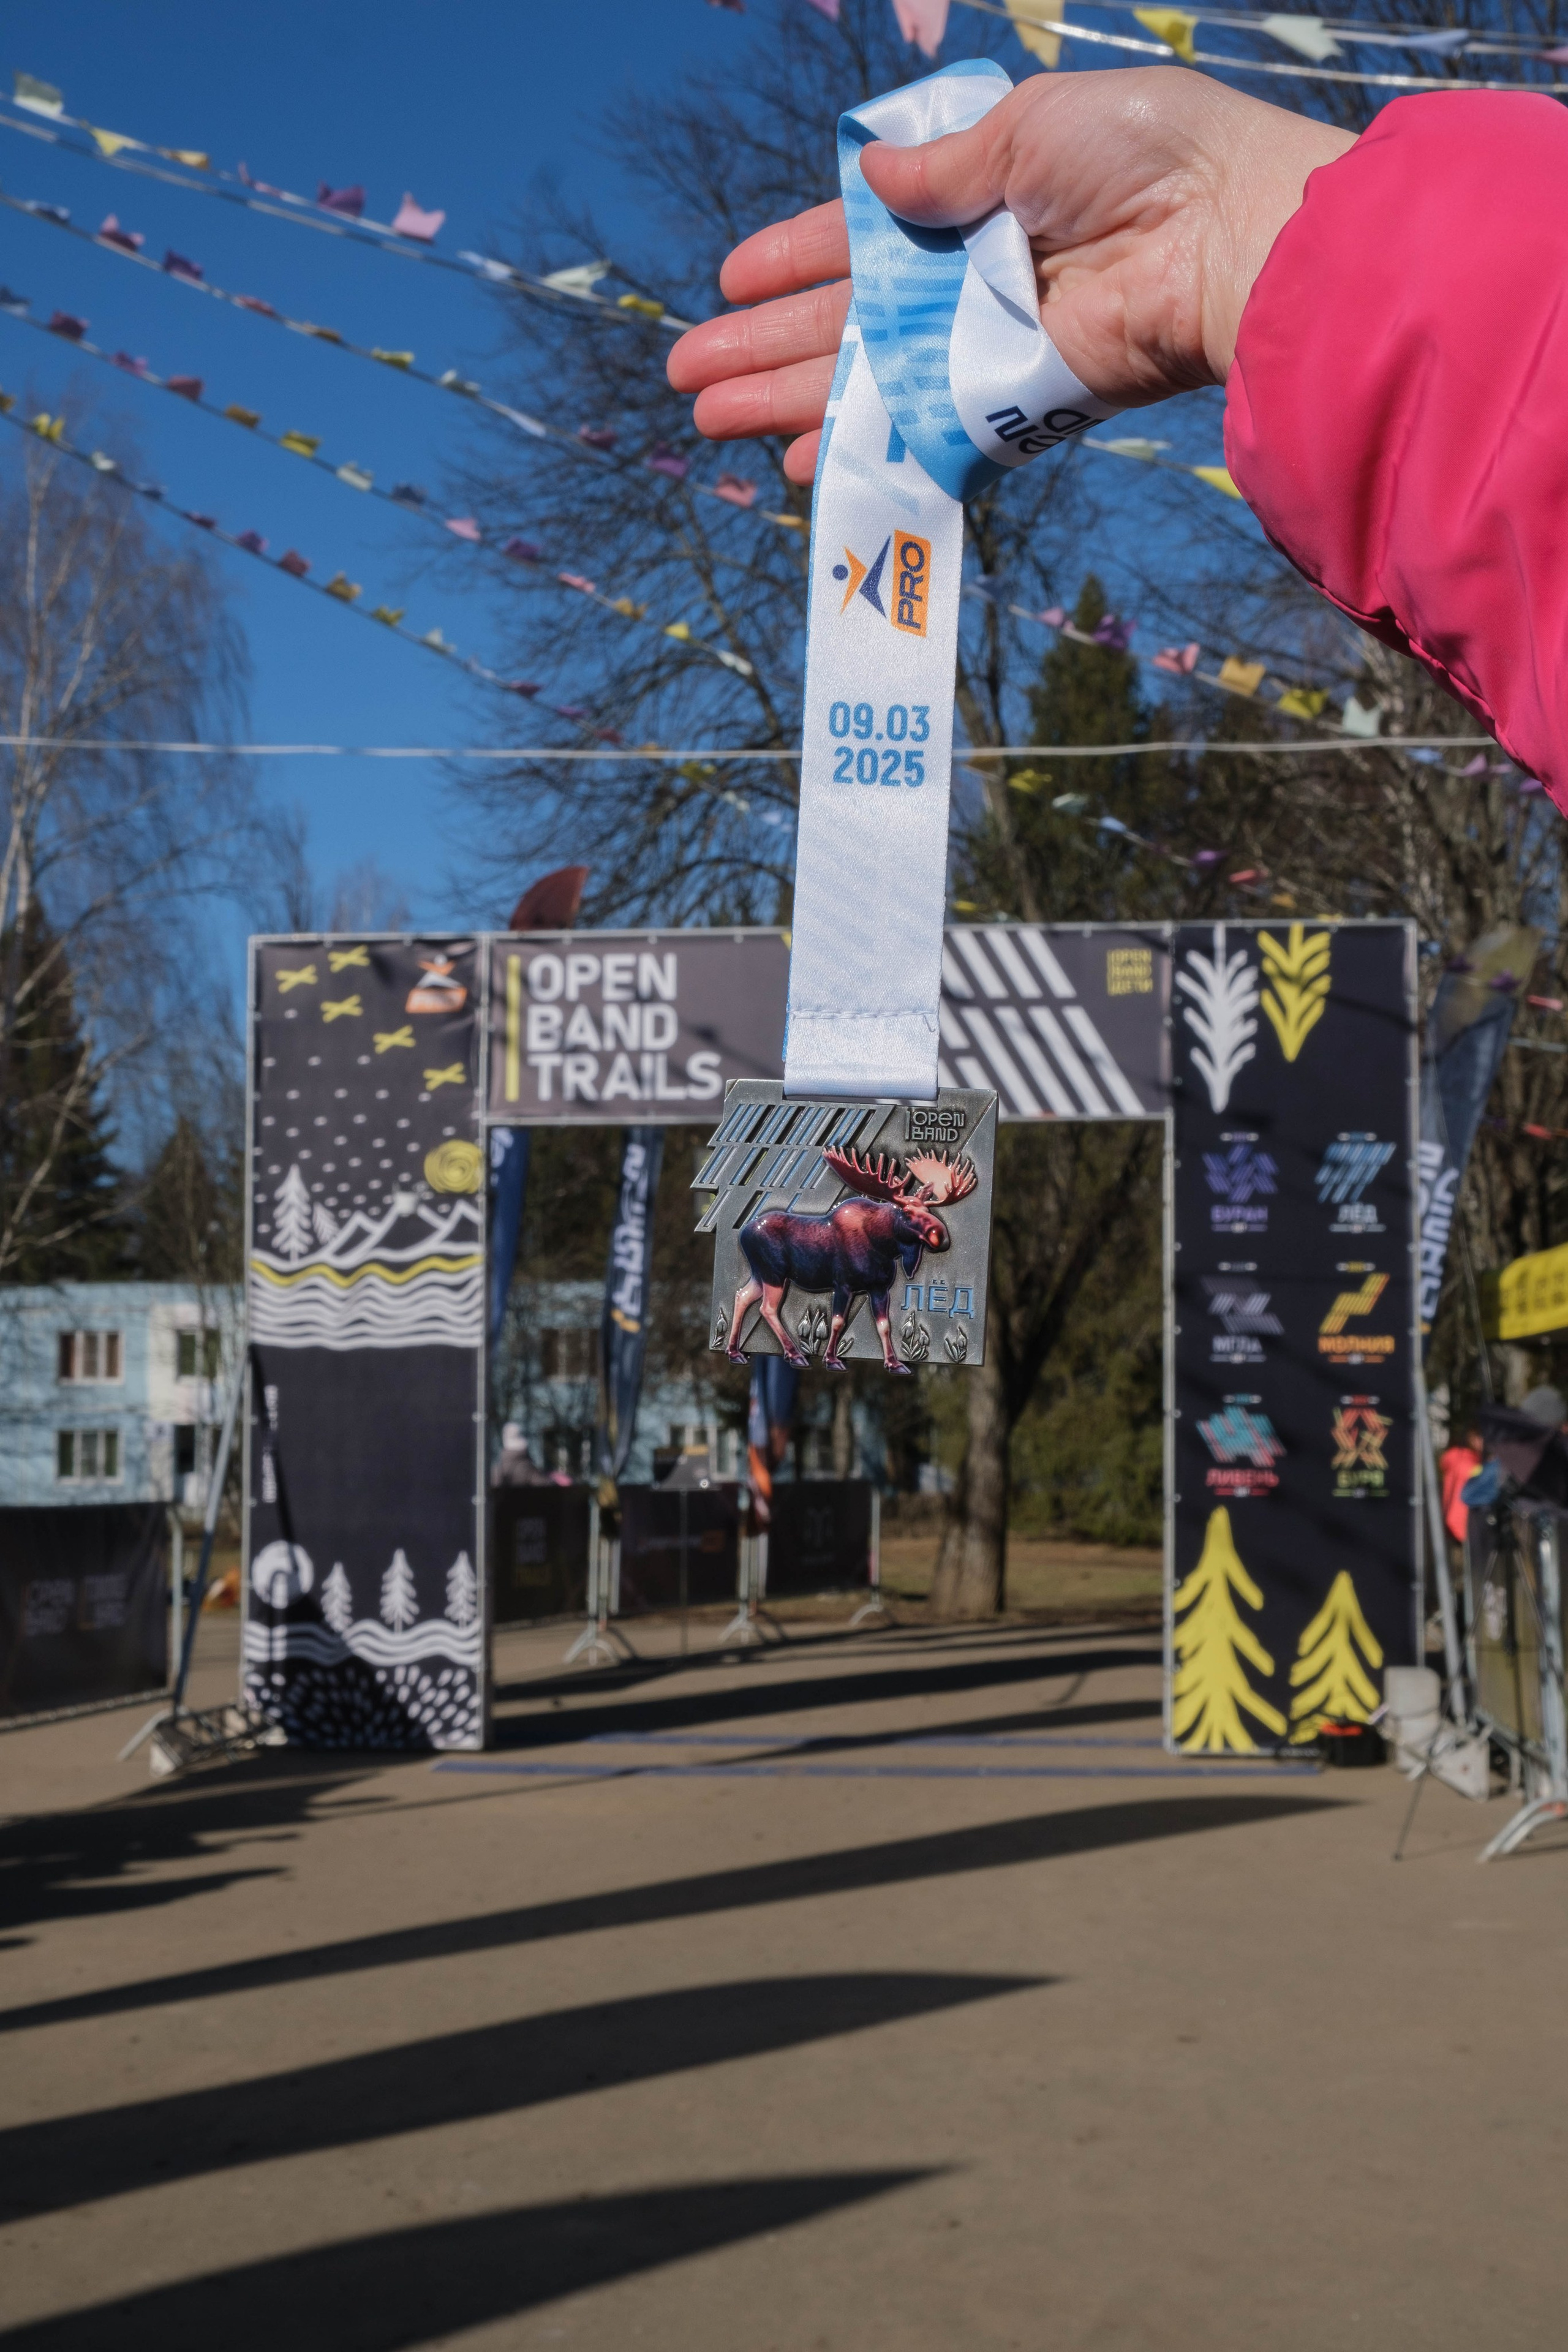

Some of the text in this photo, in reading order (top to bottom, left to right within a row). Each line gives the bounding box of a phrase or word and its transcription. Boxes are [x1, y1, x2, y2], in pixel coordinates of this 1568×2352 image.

[897, 541, 925, 629] PRO
[828, 701, 931, 742] 09.03
[832, 746, 926, 788] 2025
[527, 953, 677, 1001] OPEN
[527, 1003, 678, 1052] BAND
[527, 1051, 723, 1101] TRAILS
[911, 1126, 959, 1141] BAND
[901, 1279, 974, 1319] ЛЁД
